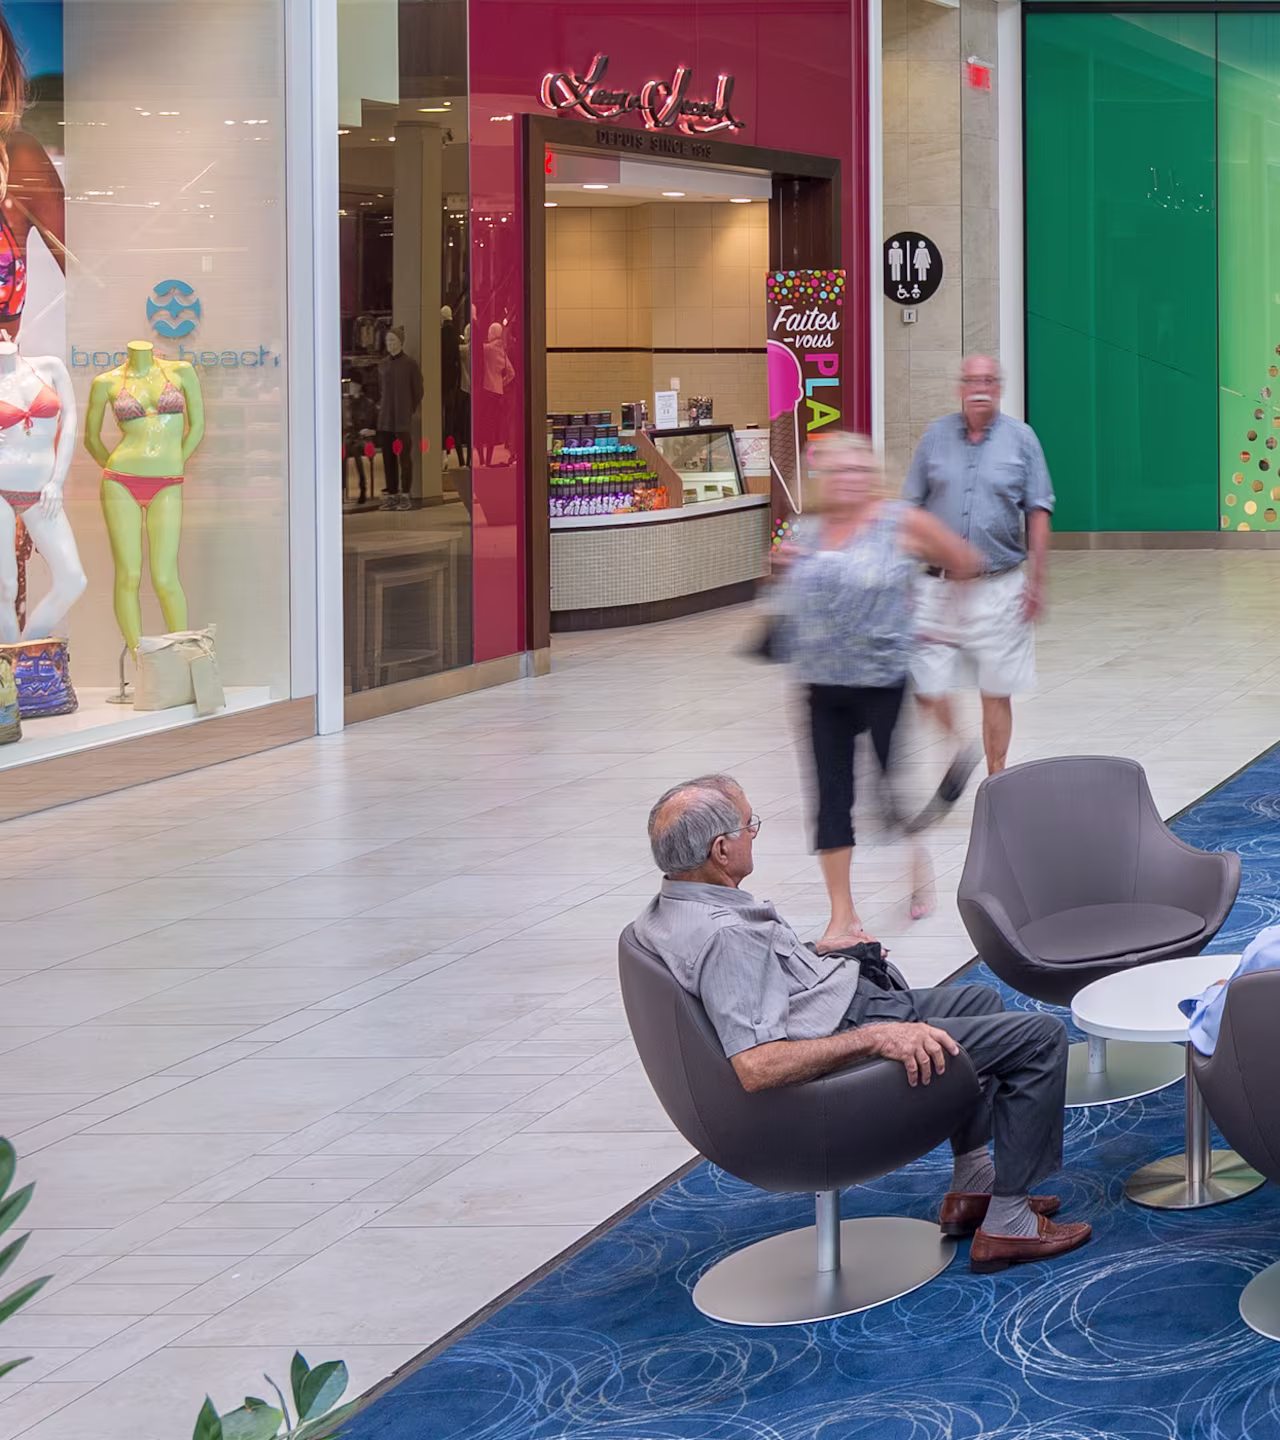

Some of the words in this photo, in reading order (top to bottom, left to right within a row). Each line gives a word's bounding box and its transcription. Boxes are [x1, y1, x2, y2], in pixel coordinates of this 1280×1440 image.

[596, 129, 644, 150] DEPUIS
[649, 135, 689, 156] SINCE
[772, 304, 841, 332] Faites
